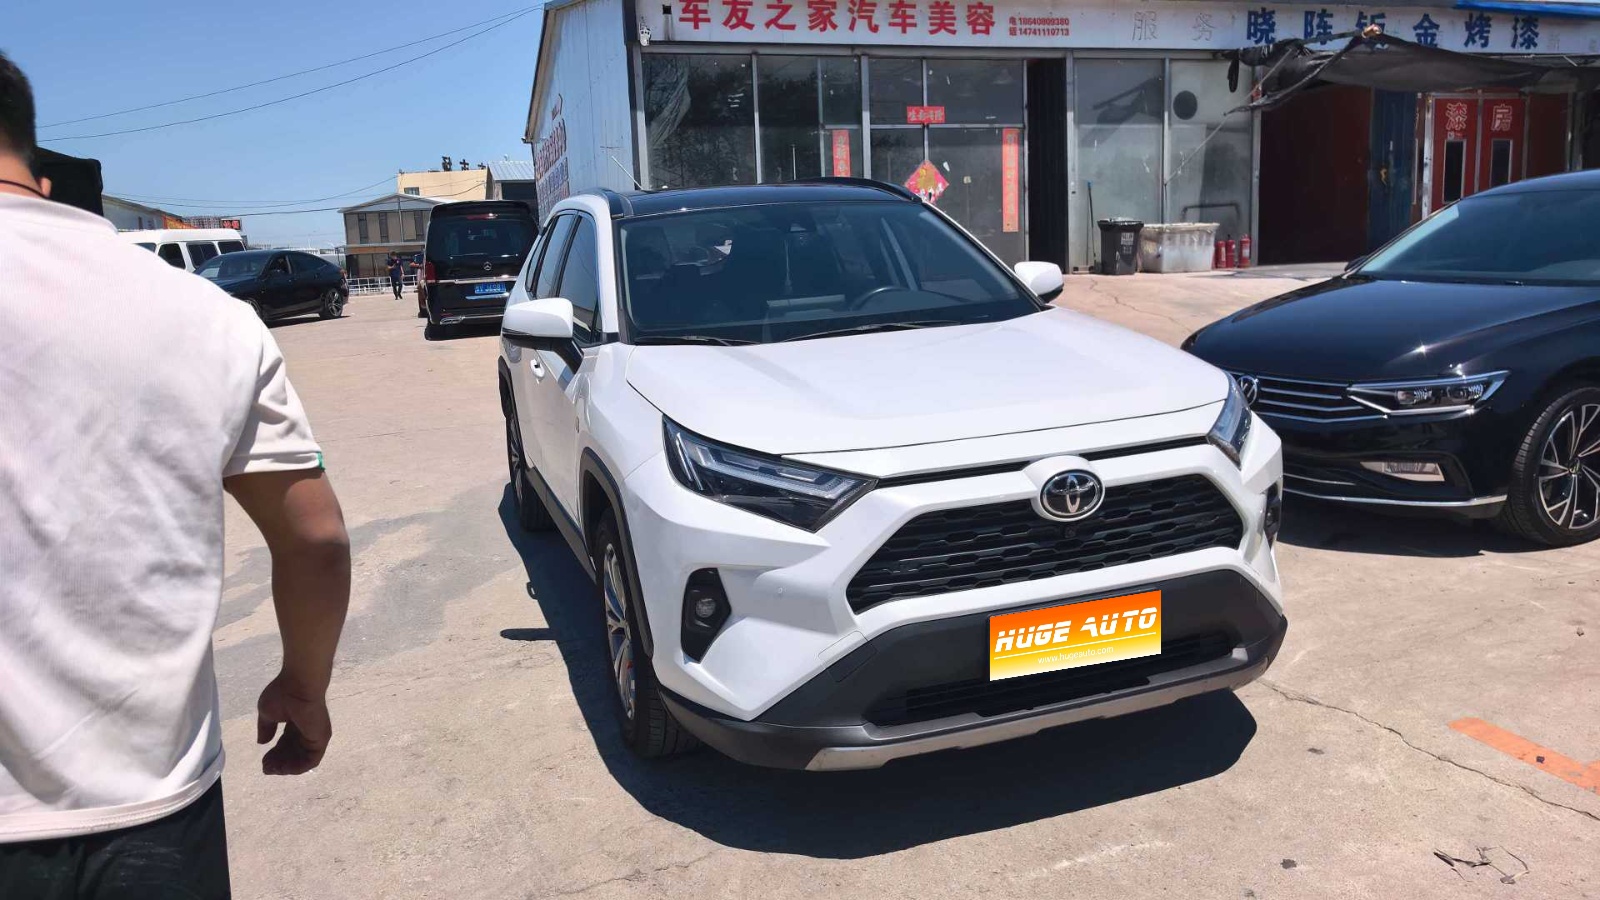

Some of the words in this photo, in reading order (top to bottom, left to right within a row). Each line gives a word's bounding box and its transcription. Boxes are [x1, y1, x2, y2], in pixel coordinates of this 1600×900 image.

[679, 0, 996, 36] 车友之家汽车美容
